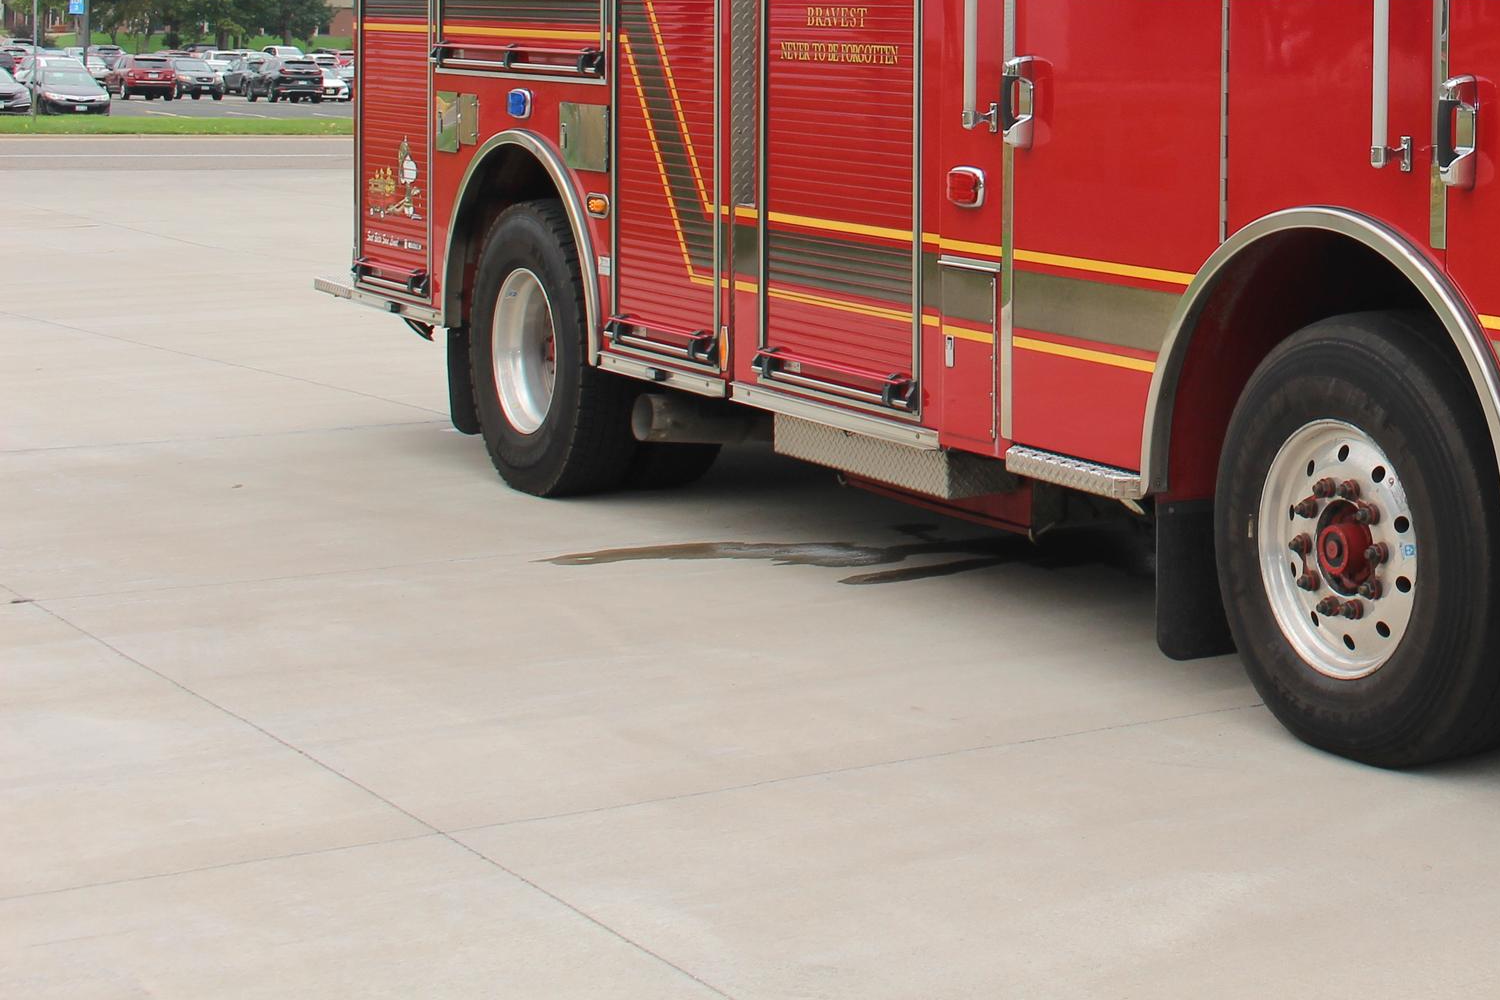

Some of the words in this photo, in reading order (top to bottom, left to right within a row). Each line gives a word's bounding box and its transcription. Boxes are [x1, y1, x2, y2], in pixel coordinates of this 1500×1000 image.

[806, 7, 868, 28] BRAVEST
[780, 41, 811, 61] NEVER
[812, 42, 826, 62] TO
[827, 43, 839, 62] BE
[841, 43, 899, 65] FORGOTTEN
